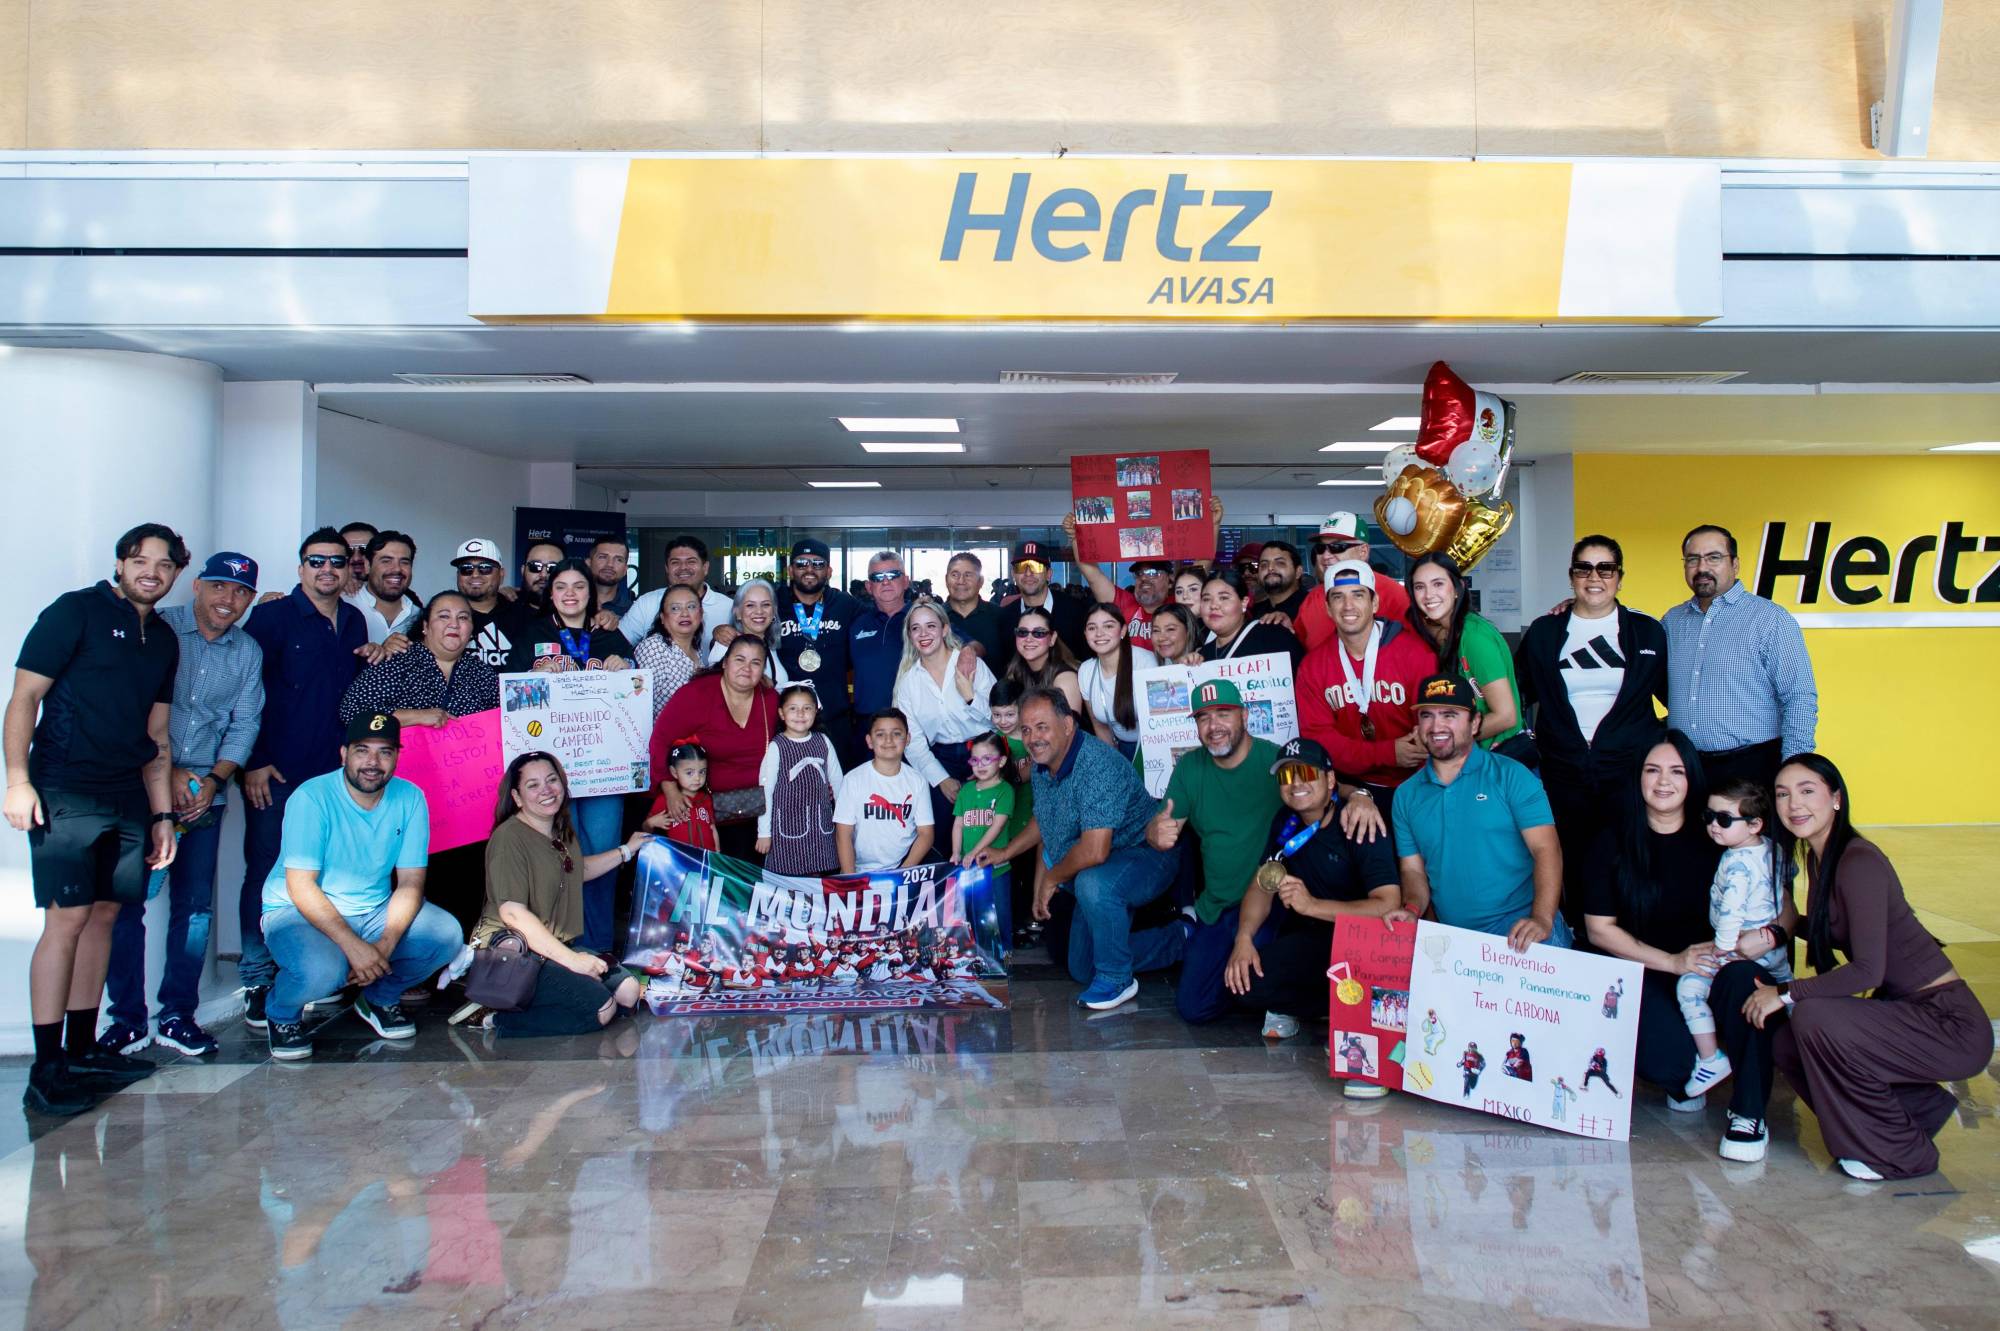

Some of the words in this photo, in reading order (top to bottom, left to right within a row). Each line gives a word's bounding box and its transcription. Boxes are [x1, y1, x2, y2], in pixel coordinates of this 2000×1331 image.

[940, 172, 1272, 262] Hertz
[1147, 276, 1274, 304] AVASA
[528, 529, 552, 538] Hertz
[1218, 664, 1234, 677] EL
[1237, 658, 1271, 674] CAPI
[559, 723, 600, 734] MANAGER
[903, 866, 936, 885] 2027
[669, 871, 729, 925] AL
[746, 876, 966, 933] MUNDIAL
[1481, 943, 1556, 976] Bienvenido
[652, 987, 851, 1003] BIENVENIDOS
[856, 989, 882, 998] A
[1520, 976, 1592, 1003] Panamericano
[1505, 998, 1561, 1025] CARDONA
